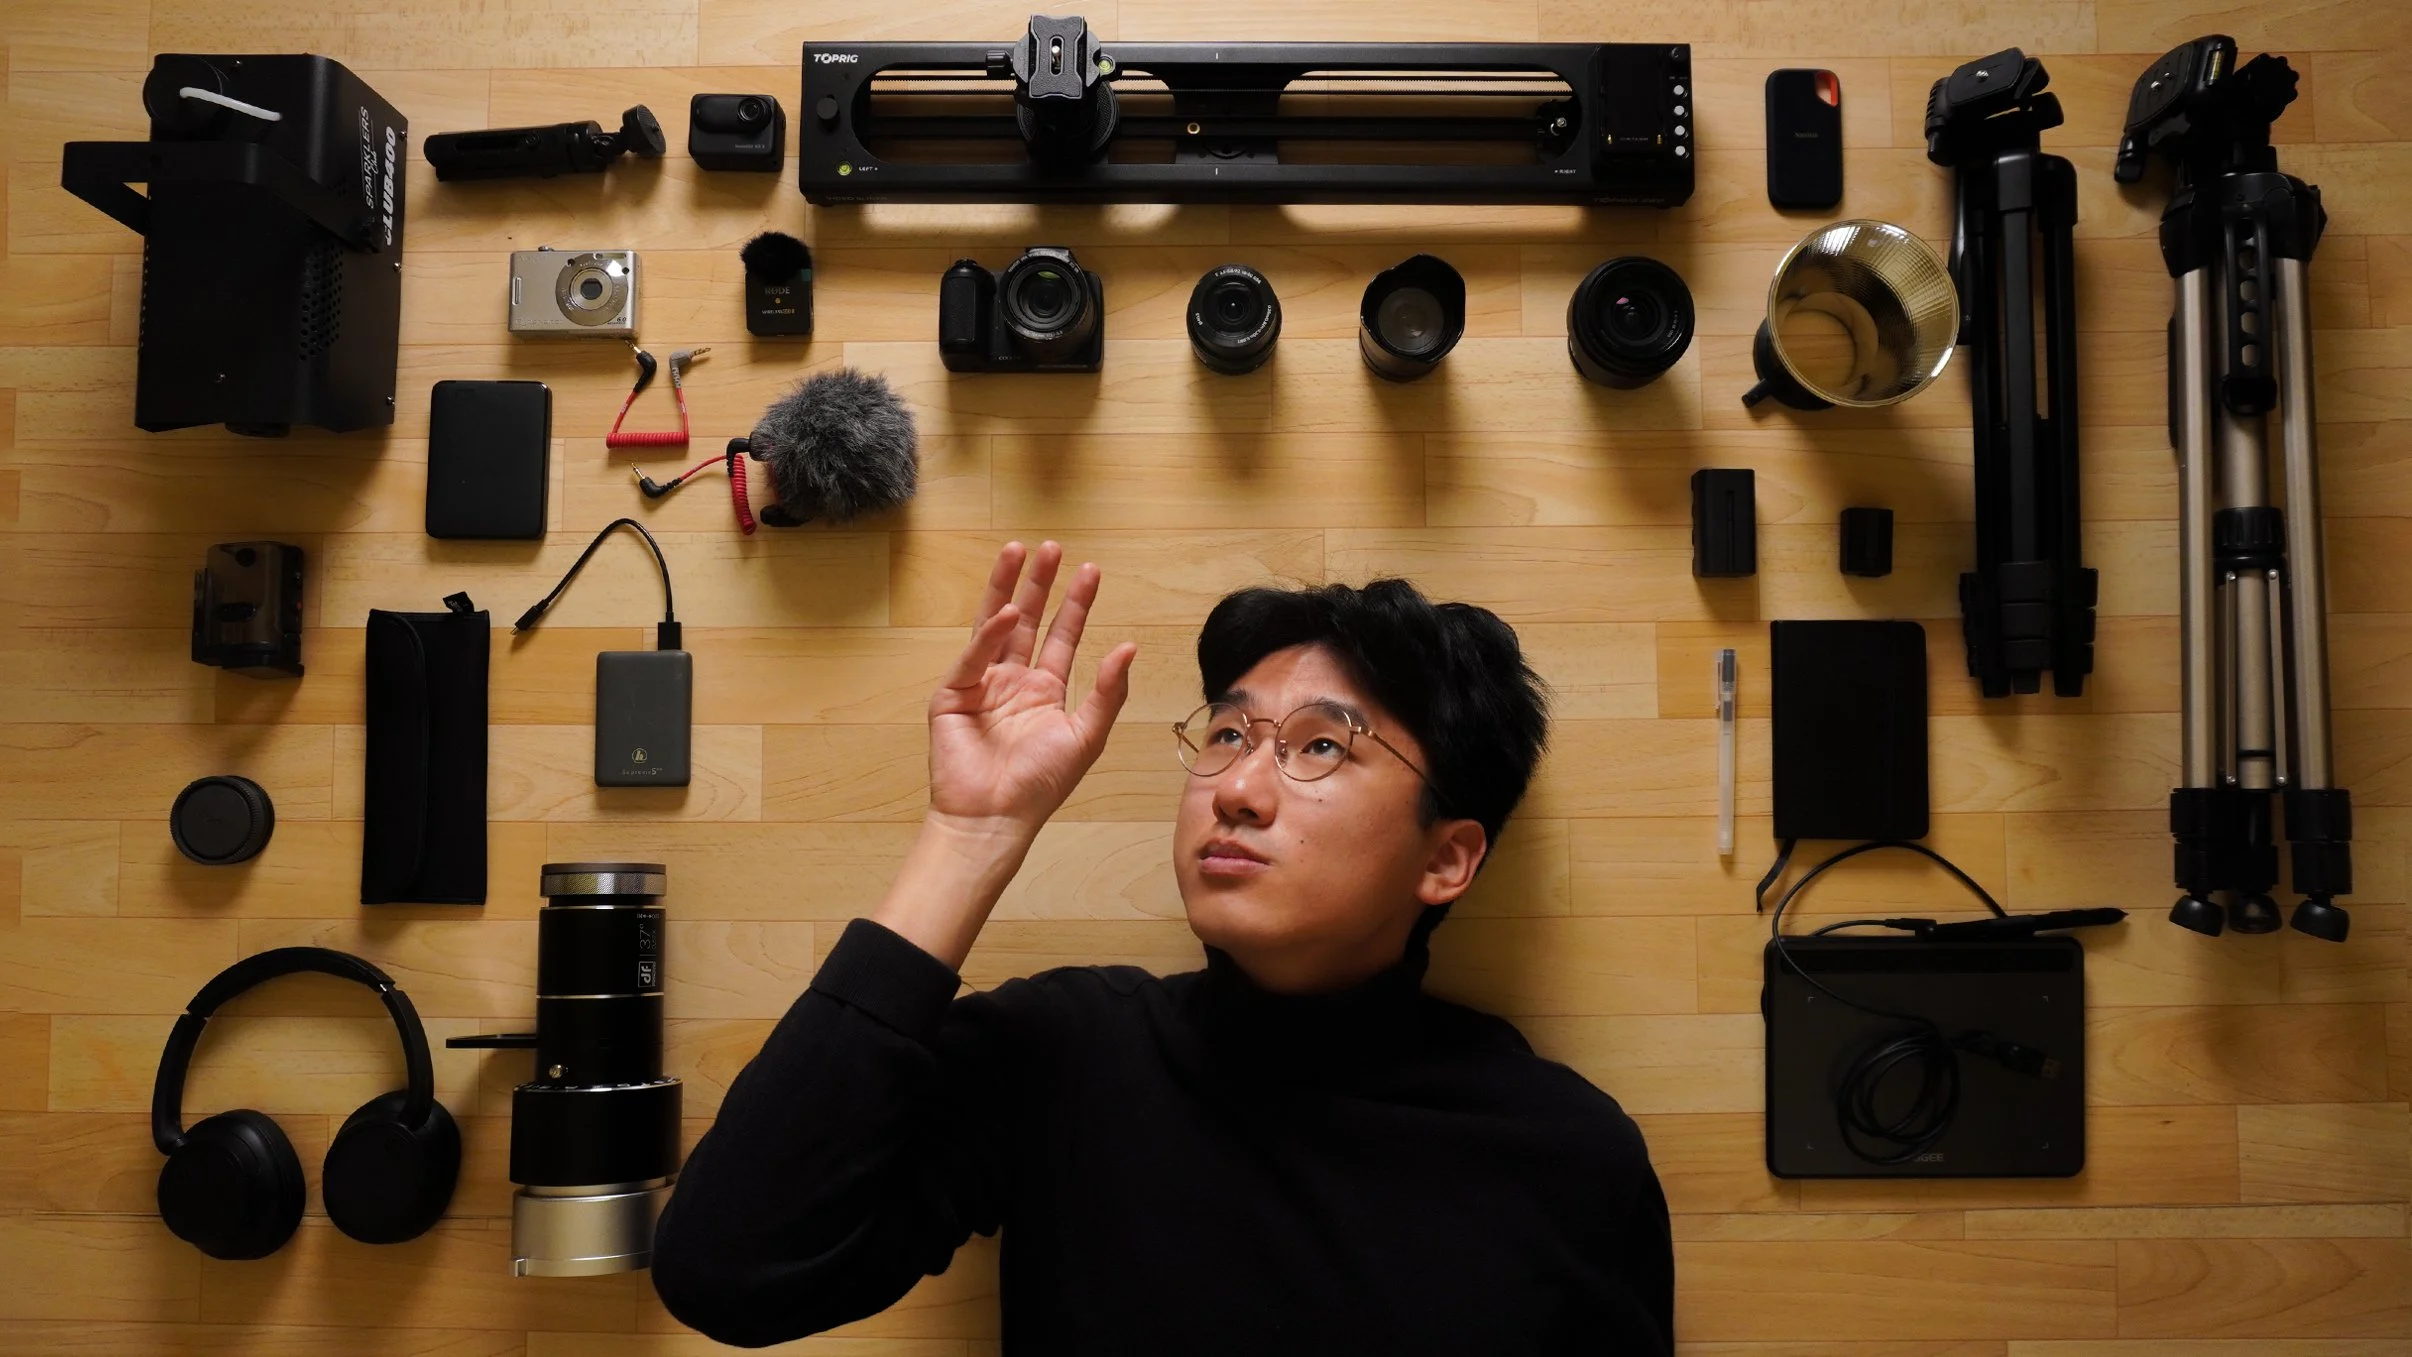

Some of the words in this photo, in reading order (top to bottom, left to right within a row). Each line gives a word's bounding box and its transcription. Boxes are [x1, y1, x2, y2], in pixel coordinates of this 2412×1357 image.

[813, 52, 859, 64] TOPRIG
[360, 105, 375, 209] SPARKLERS
[370, 149, 380, 175] Club
[382, 125, 396, 246] CLUB400
